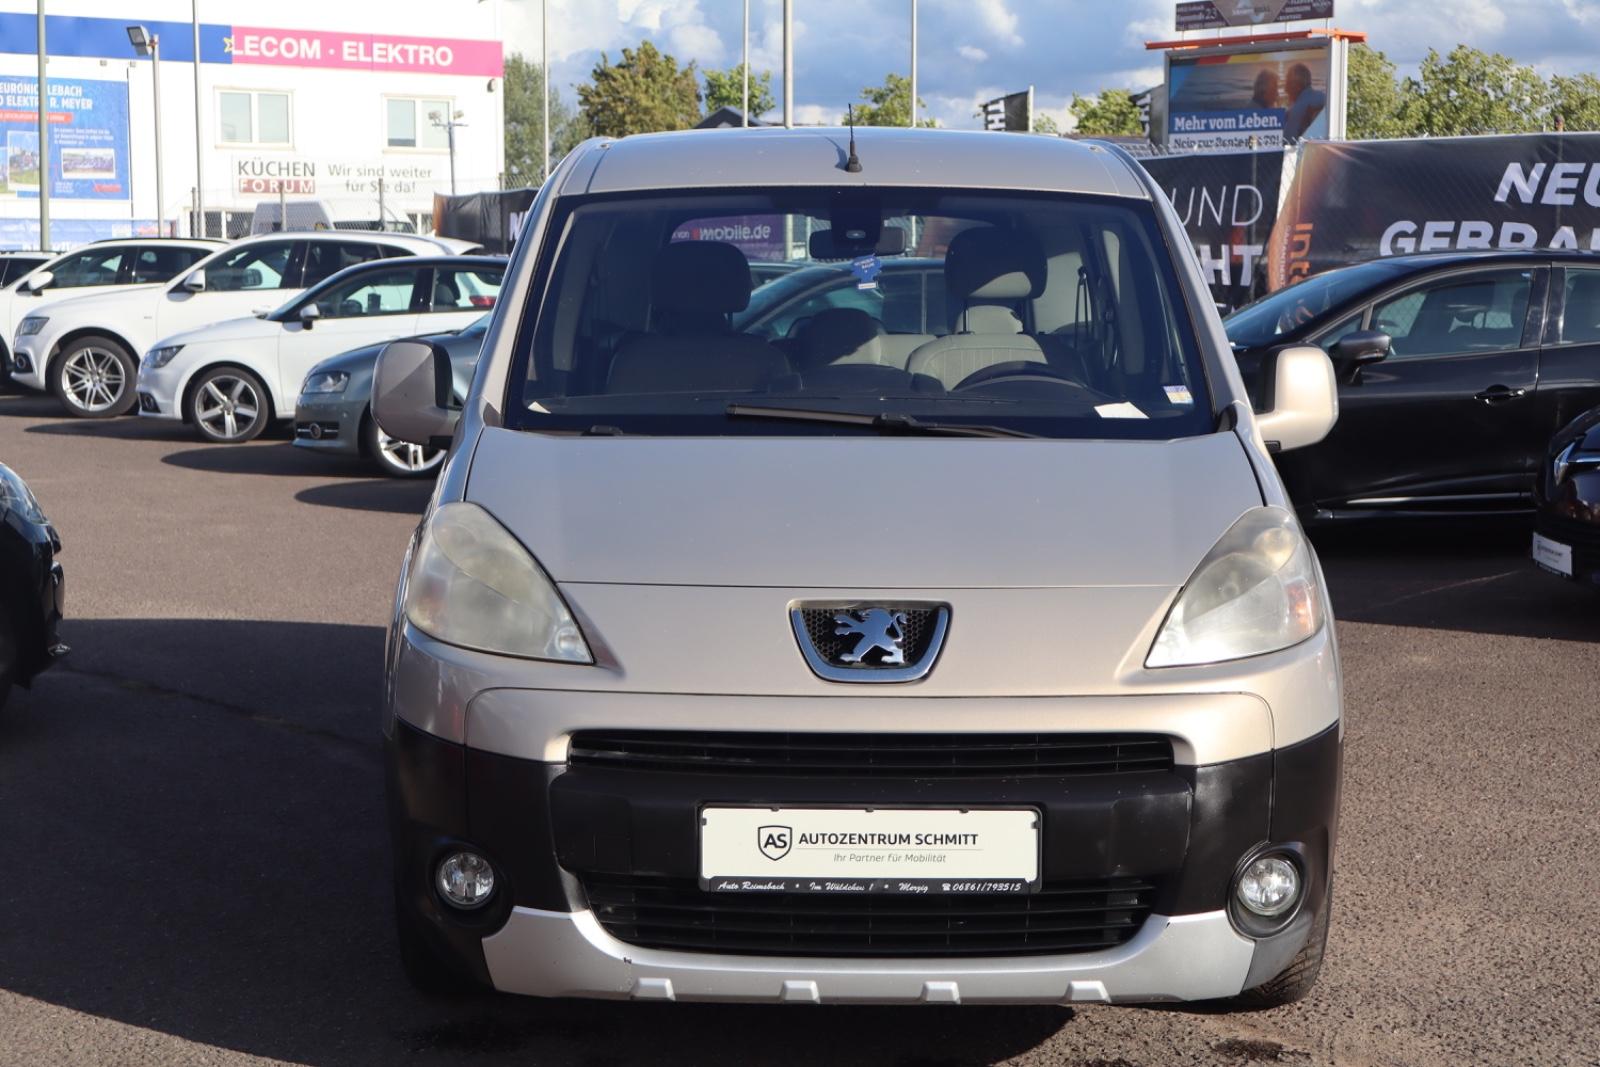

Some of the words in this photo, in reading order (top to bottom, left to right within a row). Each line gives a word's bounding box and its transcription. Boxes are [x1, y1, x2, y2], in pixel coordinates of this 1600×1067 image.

[342, 41, 454, 66] ELEKTRO
[0, 82, 39, 95] EURONIC
[47, 85, 82, 97] LEBACH
[61, 98, 93, 110] MEYER
[1174, 115, 1207, 131] Mehr
[1209, 117, 1236, 130] vom
[1238, 113, 1282, 129] Leben.
[238, 156, 315, 177] KÜCHEN
[328, 164, 352, 177] Wir
[357, 165, 385, 177] sind
[389, 166, 432, 178] weiter
[240, 179, 315, 193] FORUM
[394, 181, 416, 193] da!
[700, 224, 771, 240] mobile.de
[764, 833, 787, 849] AS
[799, 832, 911, 846] AUTOZENTRUM
[915, 833, 979, 846] SCHMITT
[834, 853, 846, 862] Ihr
[849, 853, 886, 863] Partner
[887, 853, 902, 863] für
[904, 853, 947, 863] Mobilität
[717, 881, 739, 890] Auto
[741, 881, 785, 891] Reimsbach
[809, 881, 822, 891] Im
[898, 882, 929, 893] Merzig
[952, 882, 1022, 892] 06861/793515
